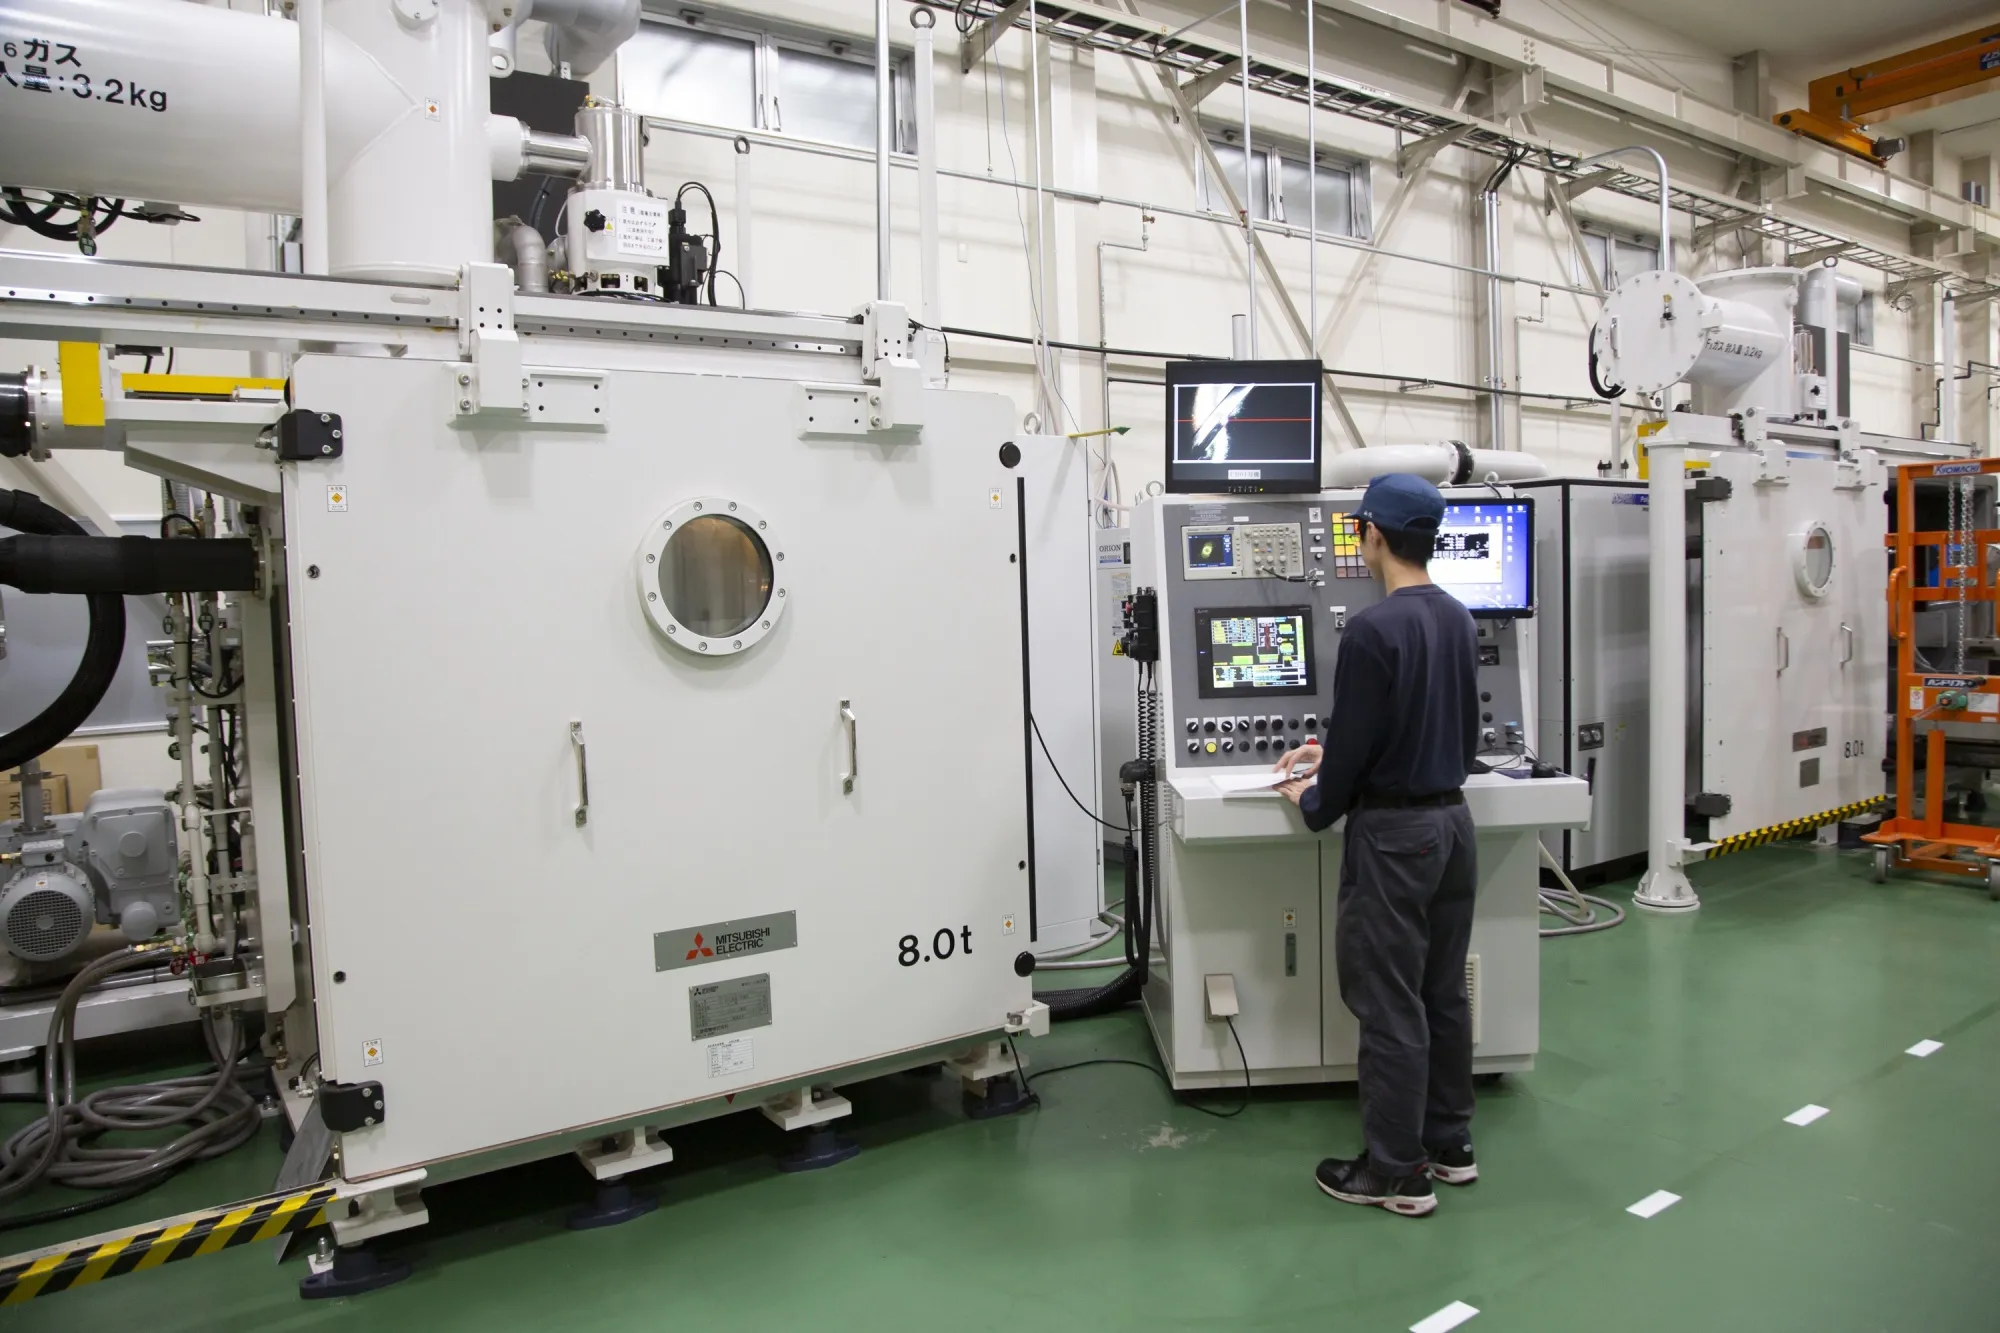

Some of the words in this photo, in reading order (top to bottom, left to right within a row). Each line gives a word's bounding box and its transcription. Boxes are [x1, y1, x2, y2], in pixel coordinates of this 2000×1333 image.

[1098, 544, 1122, 552] ORION
[715, 927, 771, 945] MITSUBISHI
[716, 938, 764, 955] ELECTRIC
[897, 924, 973, 967] 8.0t
